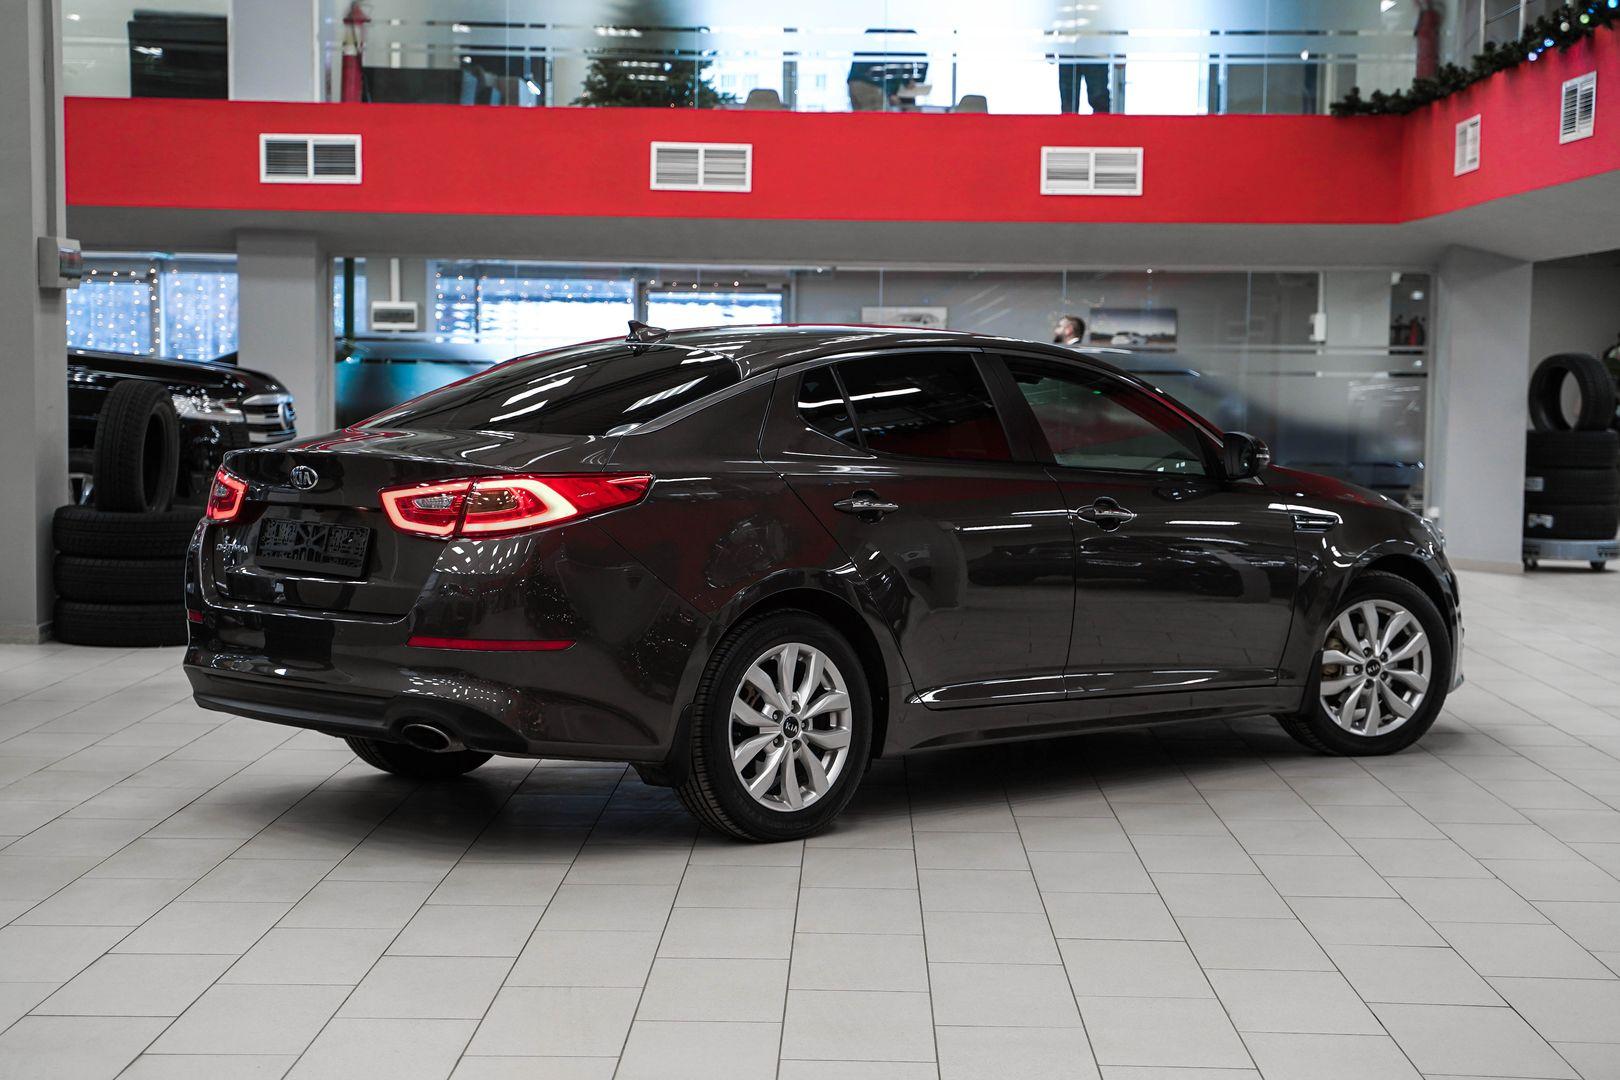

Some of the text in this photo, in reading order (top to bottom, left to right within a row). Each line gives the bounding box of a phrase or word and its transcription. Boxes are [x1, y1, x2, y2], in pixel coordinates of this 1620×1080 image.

[291, 468, 314, 487] KIA
[1366, 663, 1380, 674] KIA
[784, 721, 798, 733] KIA
